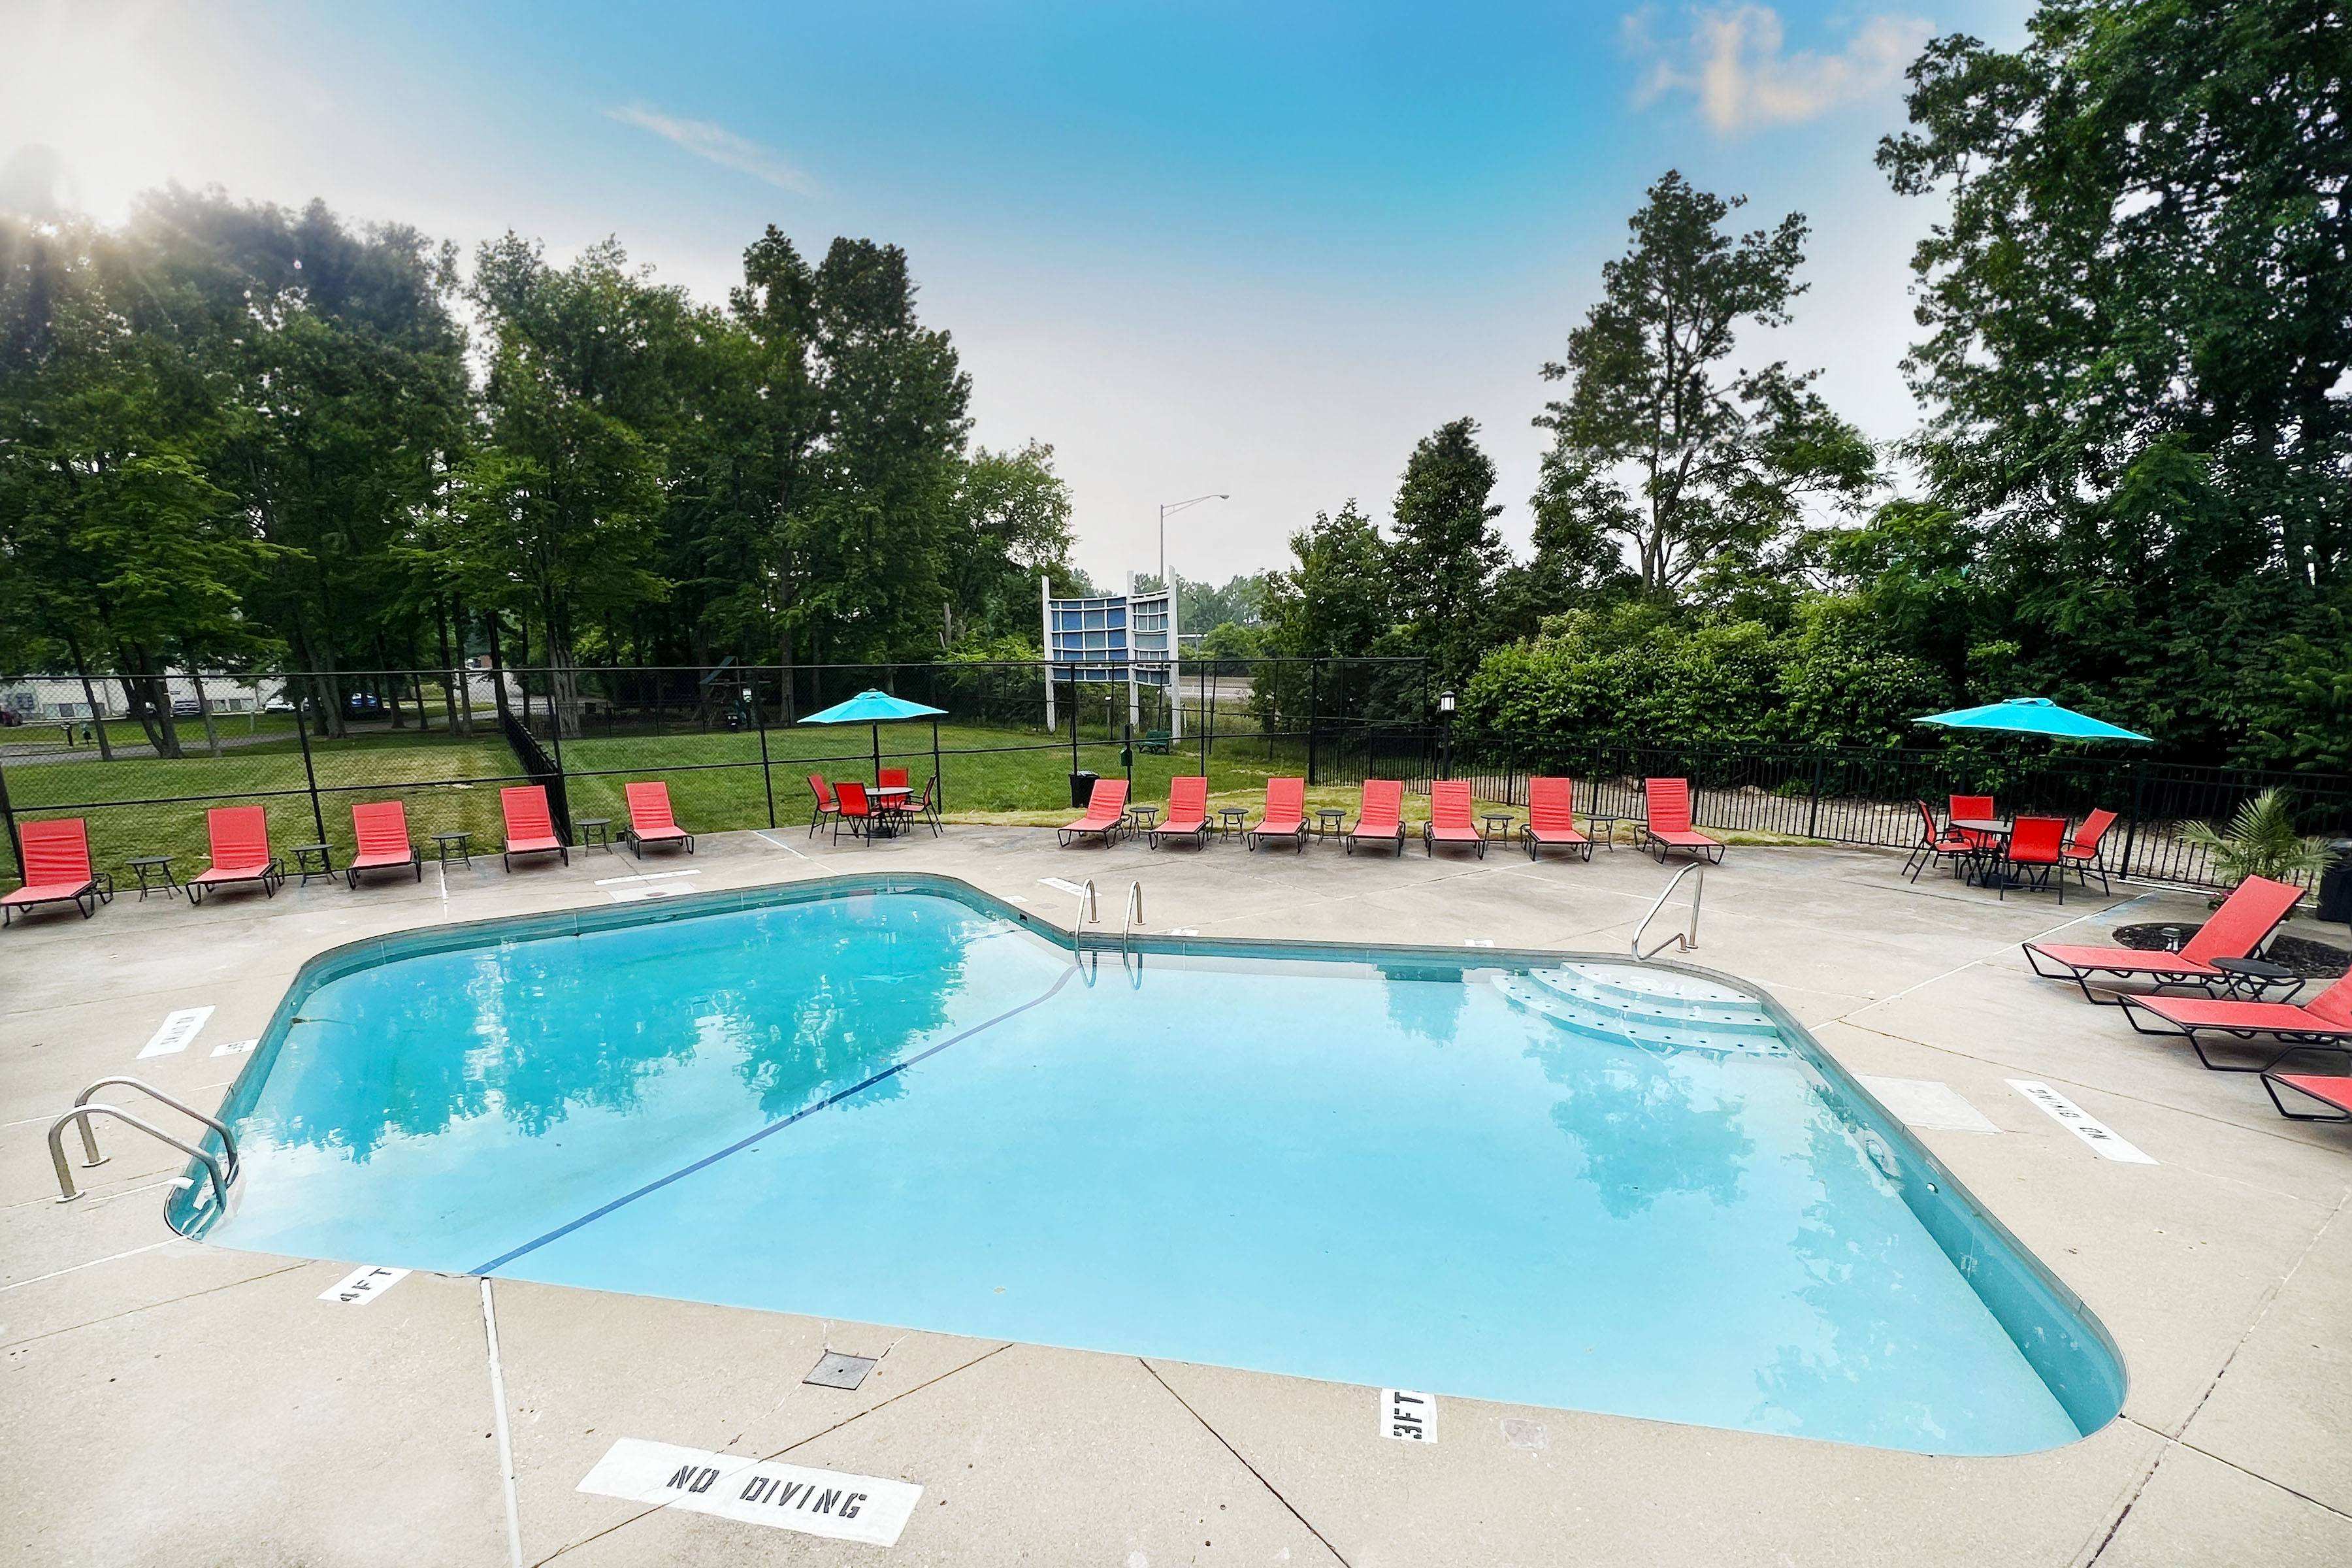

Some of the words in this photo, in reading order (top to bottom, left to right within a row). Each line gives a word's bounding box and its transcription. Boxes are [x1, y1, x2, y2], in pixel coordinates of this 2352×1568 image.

[1394, 1392, 1424, 1439] 3FT
[666, 1465, 720, 1493] NO
[740, 1476, 868, 1519] DIVING
